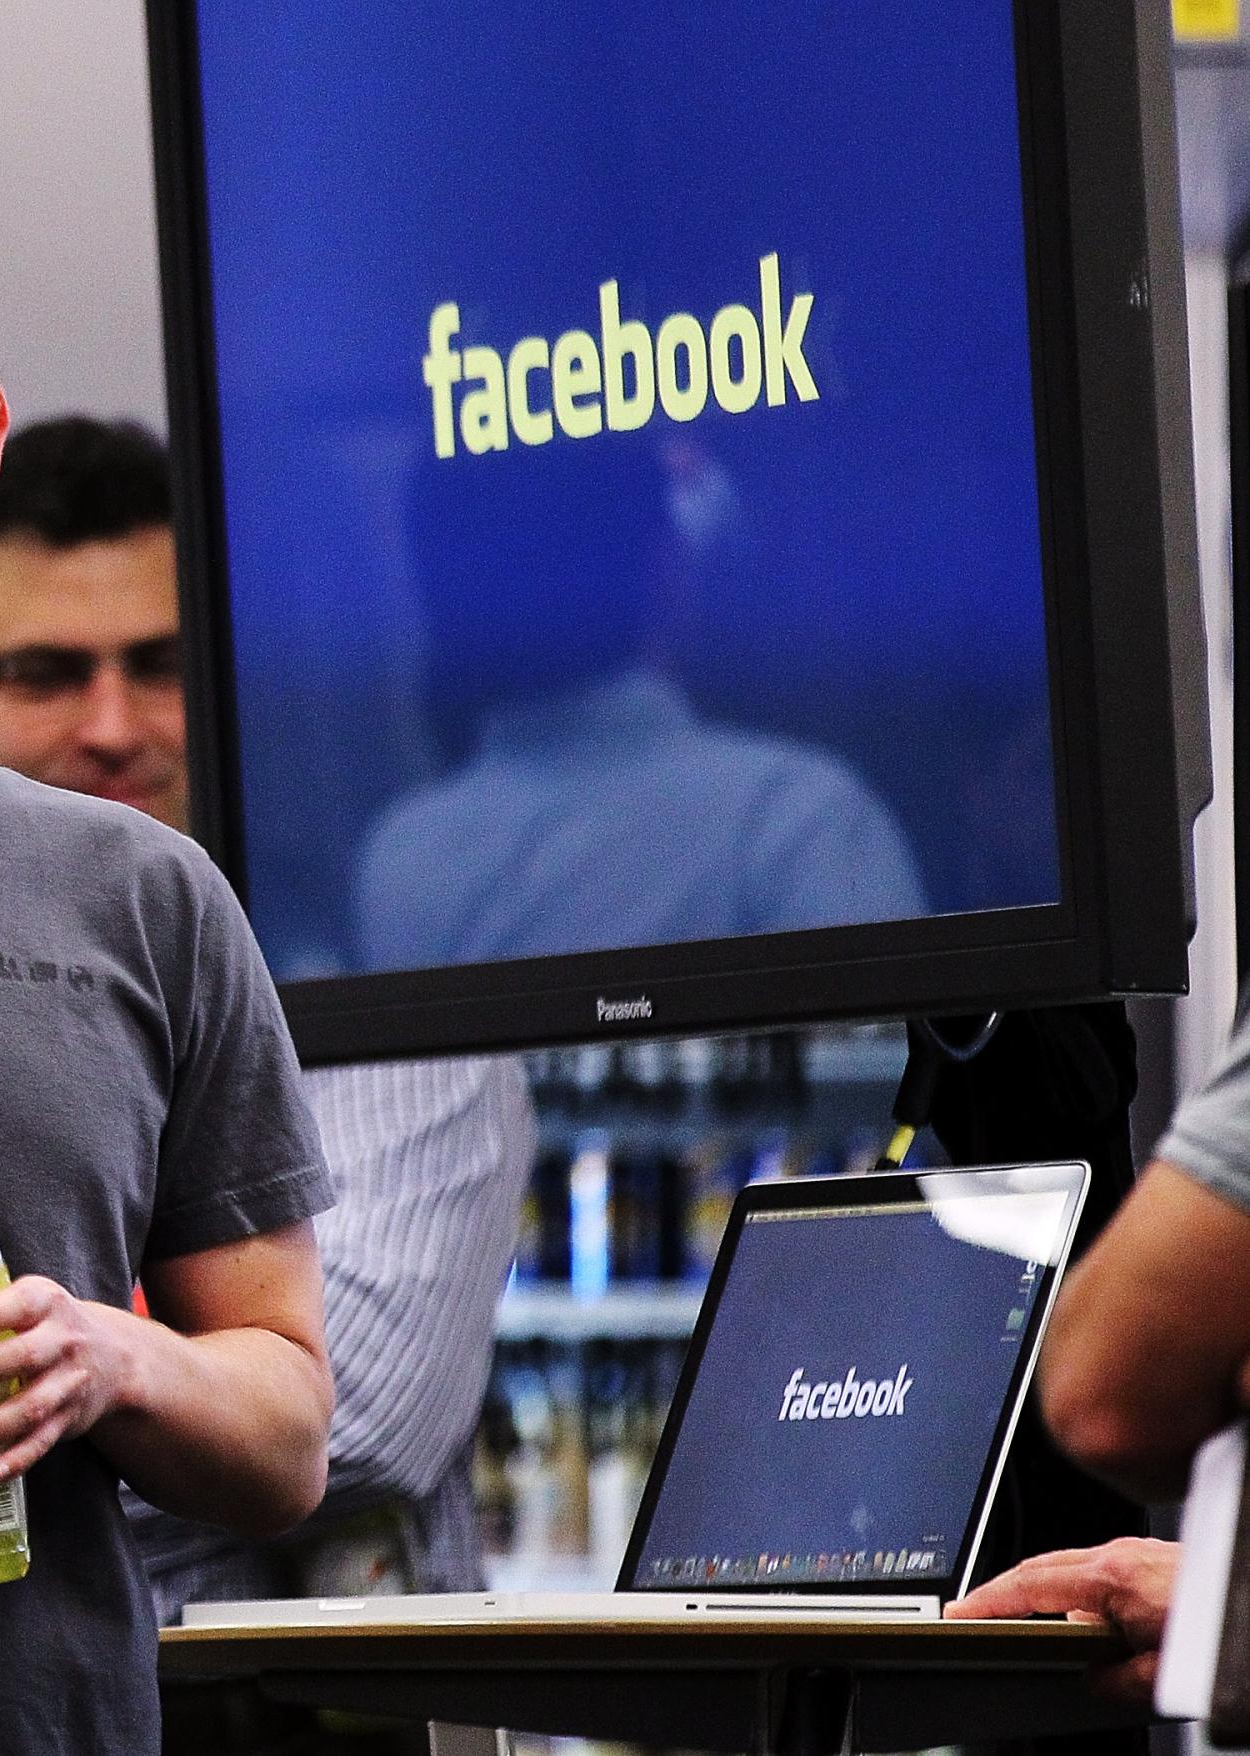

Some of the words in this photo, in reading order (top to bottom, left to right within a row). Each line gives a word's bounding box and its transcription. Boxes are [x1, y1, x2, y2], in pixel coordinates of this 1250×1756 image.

[423, 252, 820, 459] facebook
[596, 994, 653, 1021] Panasonic
[778, 1363, 915, 1421] facebook
